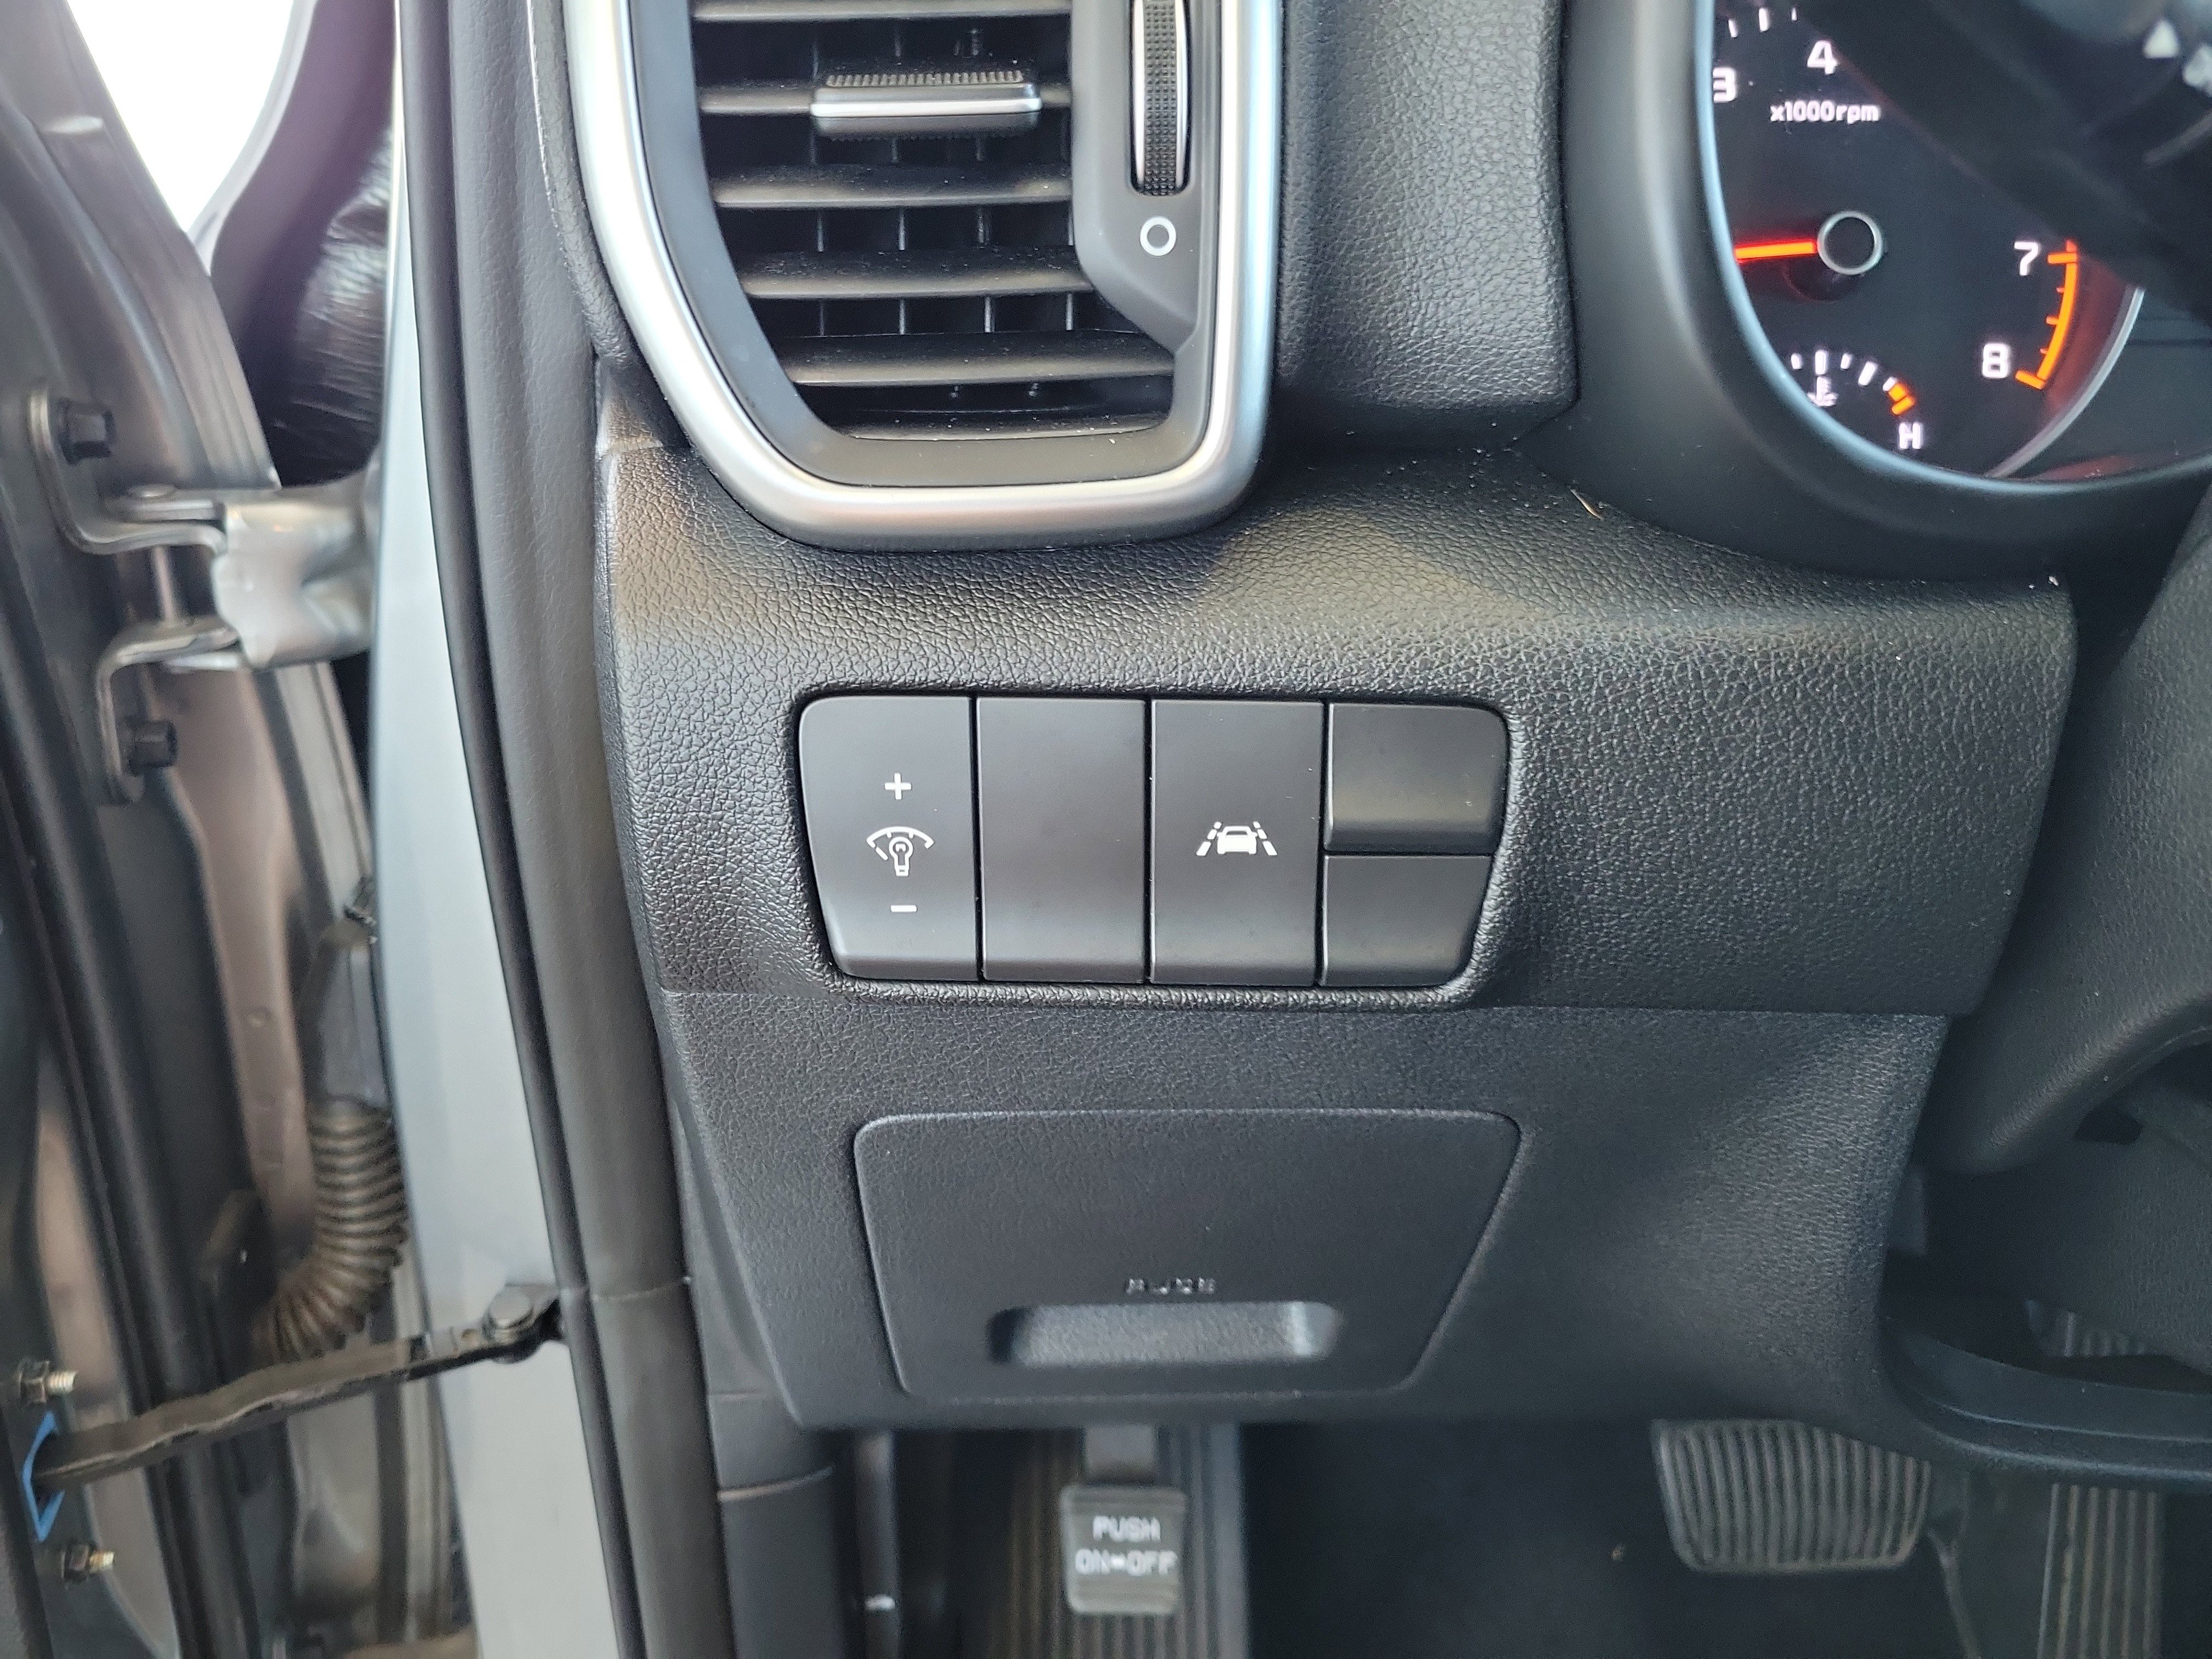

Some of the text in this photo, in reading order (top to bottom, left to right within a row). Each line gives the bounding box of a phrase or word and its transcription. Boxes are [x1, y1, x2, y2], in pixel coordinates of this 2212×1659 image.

[1806, 40, 1838, 75] 4
[1712, 67, 1737, 103] 3
[1770, 100, 1880, 124] x1000rpm
[2014, 241, 2040, 276] 7
[1982, 344, 2010, 379] 8
[1898, 422, 1922, 450] H
[1093, 1515, 1161, 1543] PUSH
